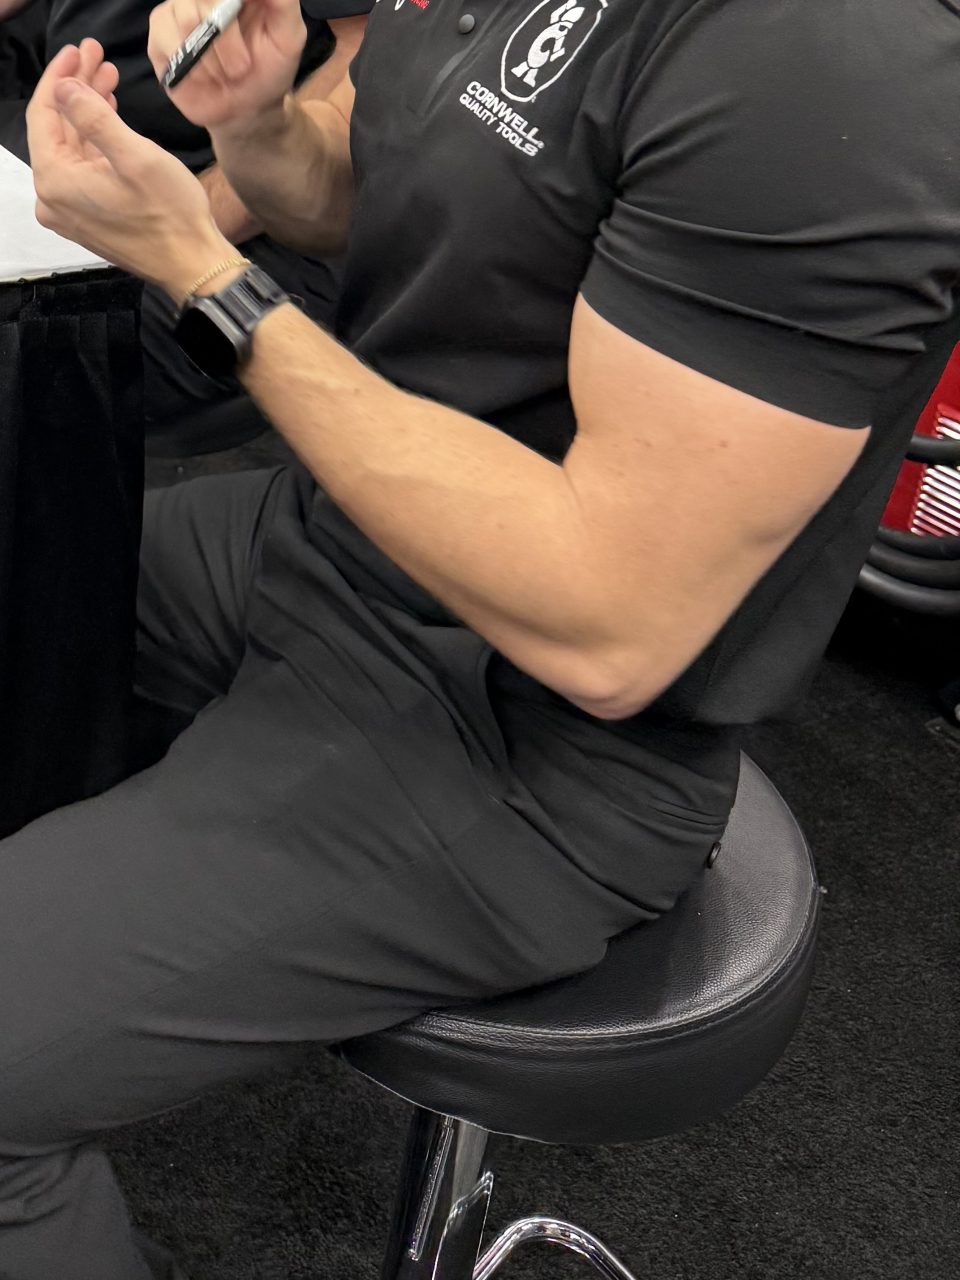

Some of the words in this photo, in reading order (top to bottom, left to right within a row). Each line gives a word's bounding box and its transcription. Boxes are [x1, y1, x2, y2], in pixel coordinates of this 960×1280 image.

[459, 92, 497, 126] QUALITY
[495, 121, 539, 157] TOOLS
[466, 80, 542, 146] CORNWELL
